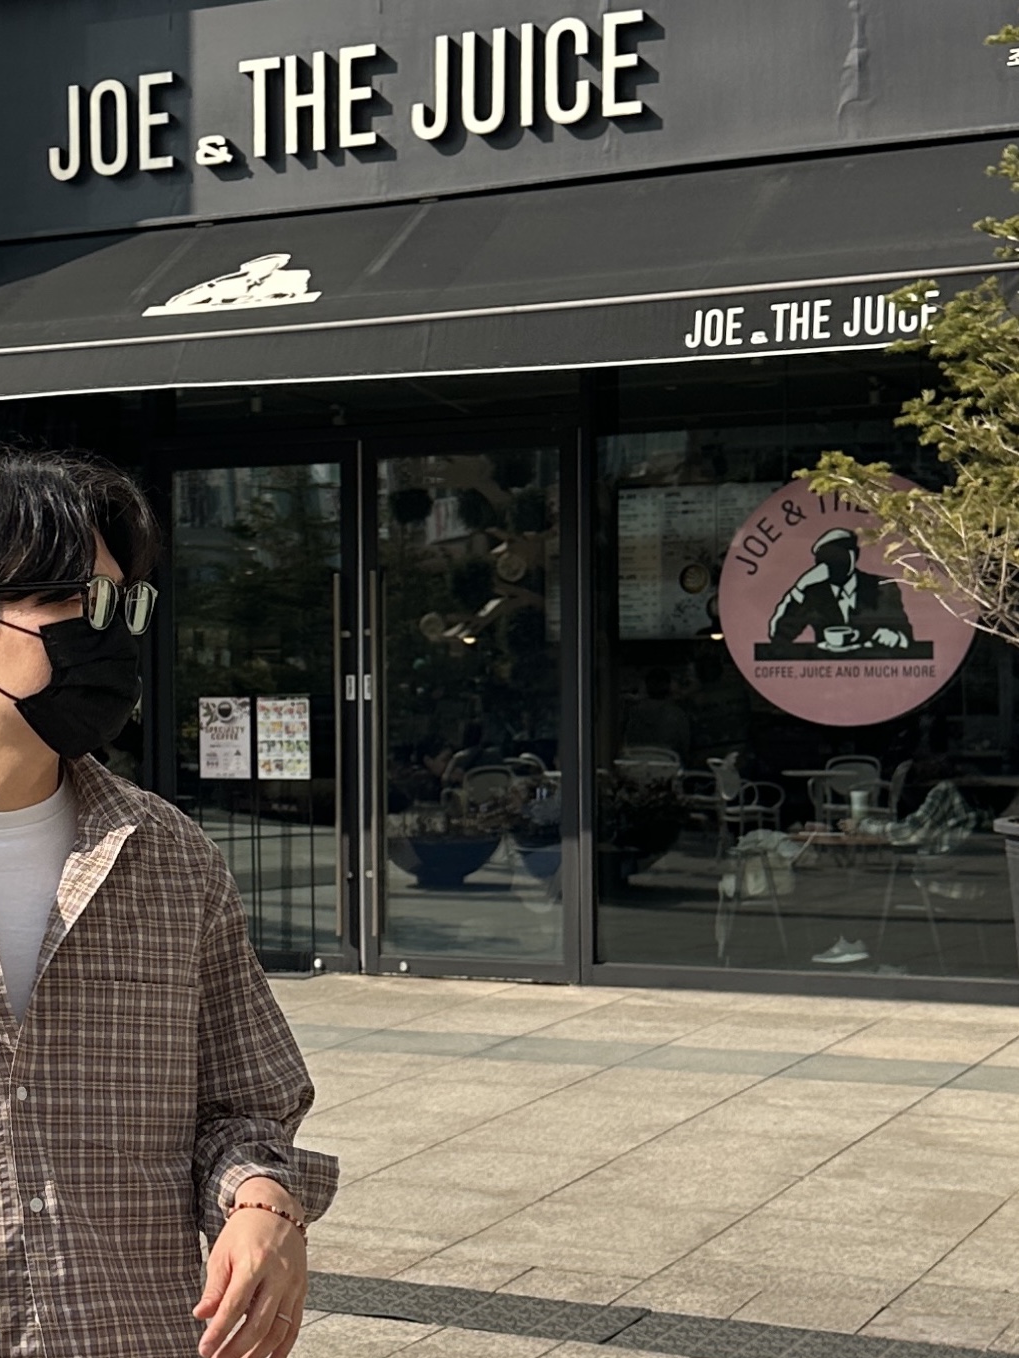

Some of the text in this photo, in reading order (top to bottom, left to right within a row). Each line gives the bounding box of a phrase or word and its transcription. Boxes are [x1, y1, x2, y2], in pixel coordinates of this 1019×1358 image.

[49, 9, 644, 181] JOE & THE JUICE
[684, 306, 745, 349] JOE
[770, 299, 832, 343] THE
[735, 516, 783, 576] JOE
[781, 499, 808, 527] &
[754, 664, 937, 679] COFFEE, JUICE AND MUCH MORE
